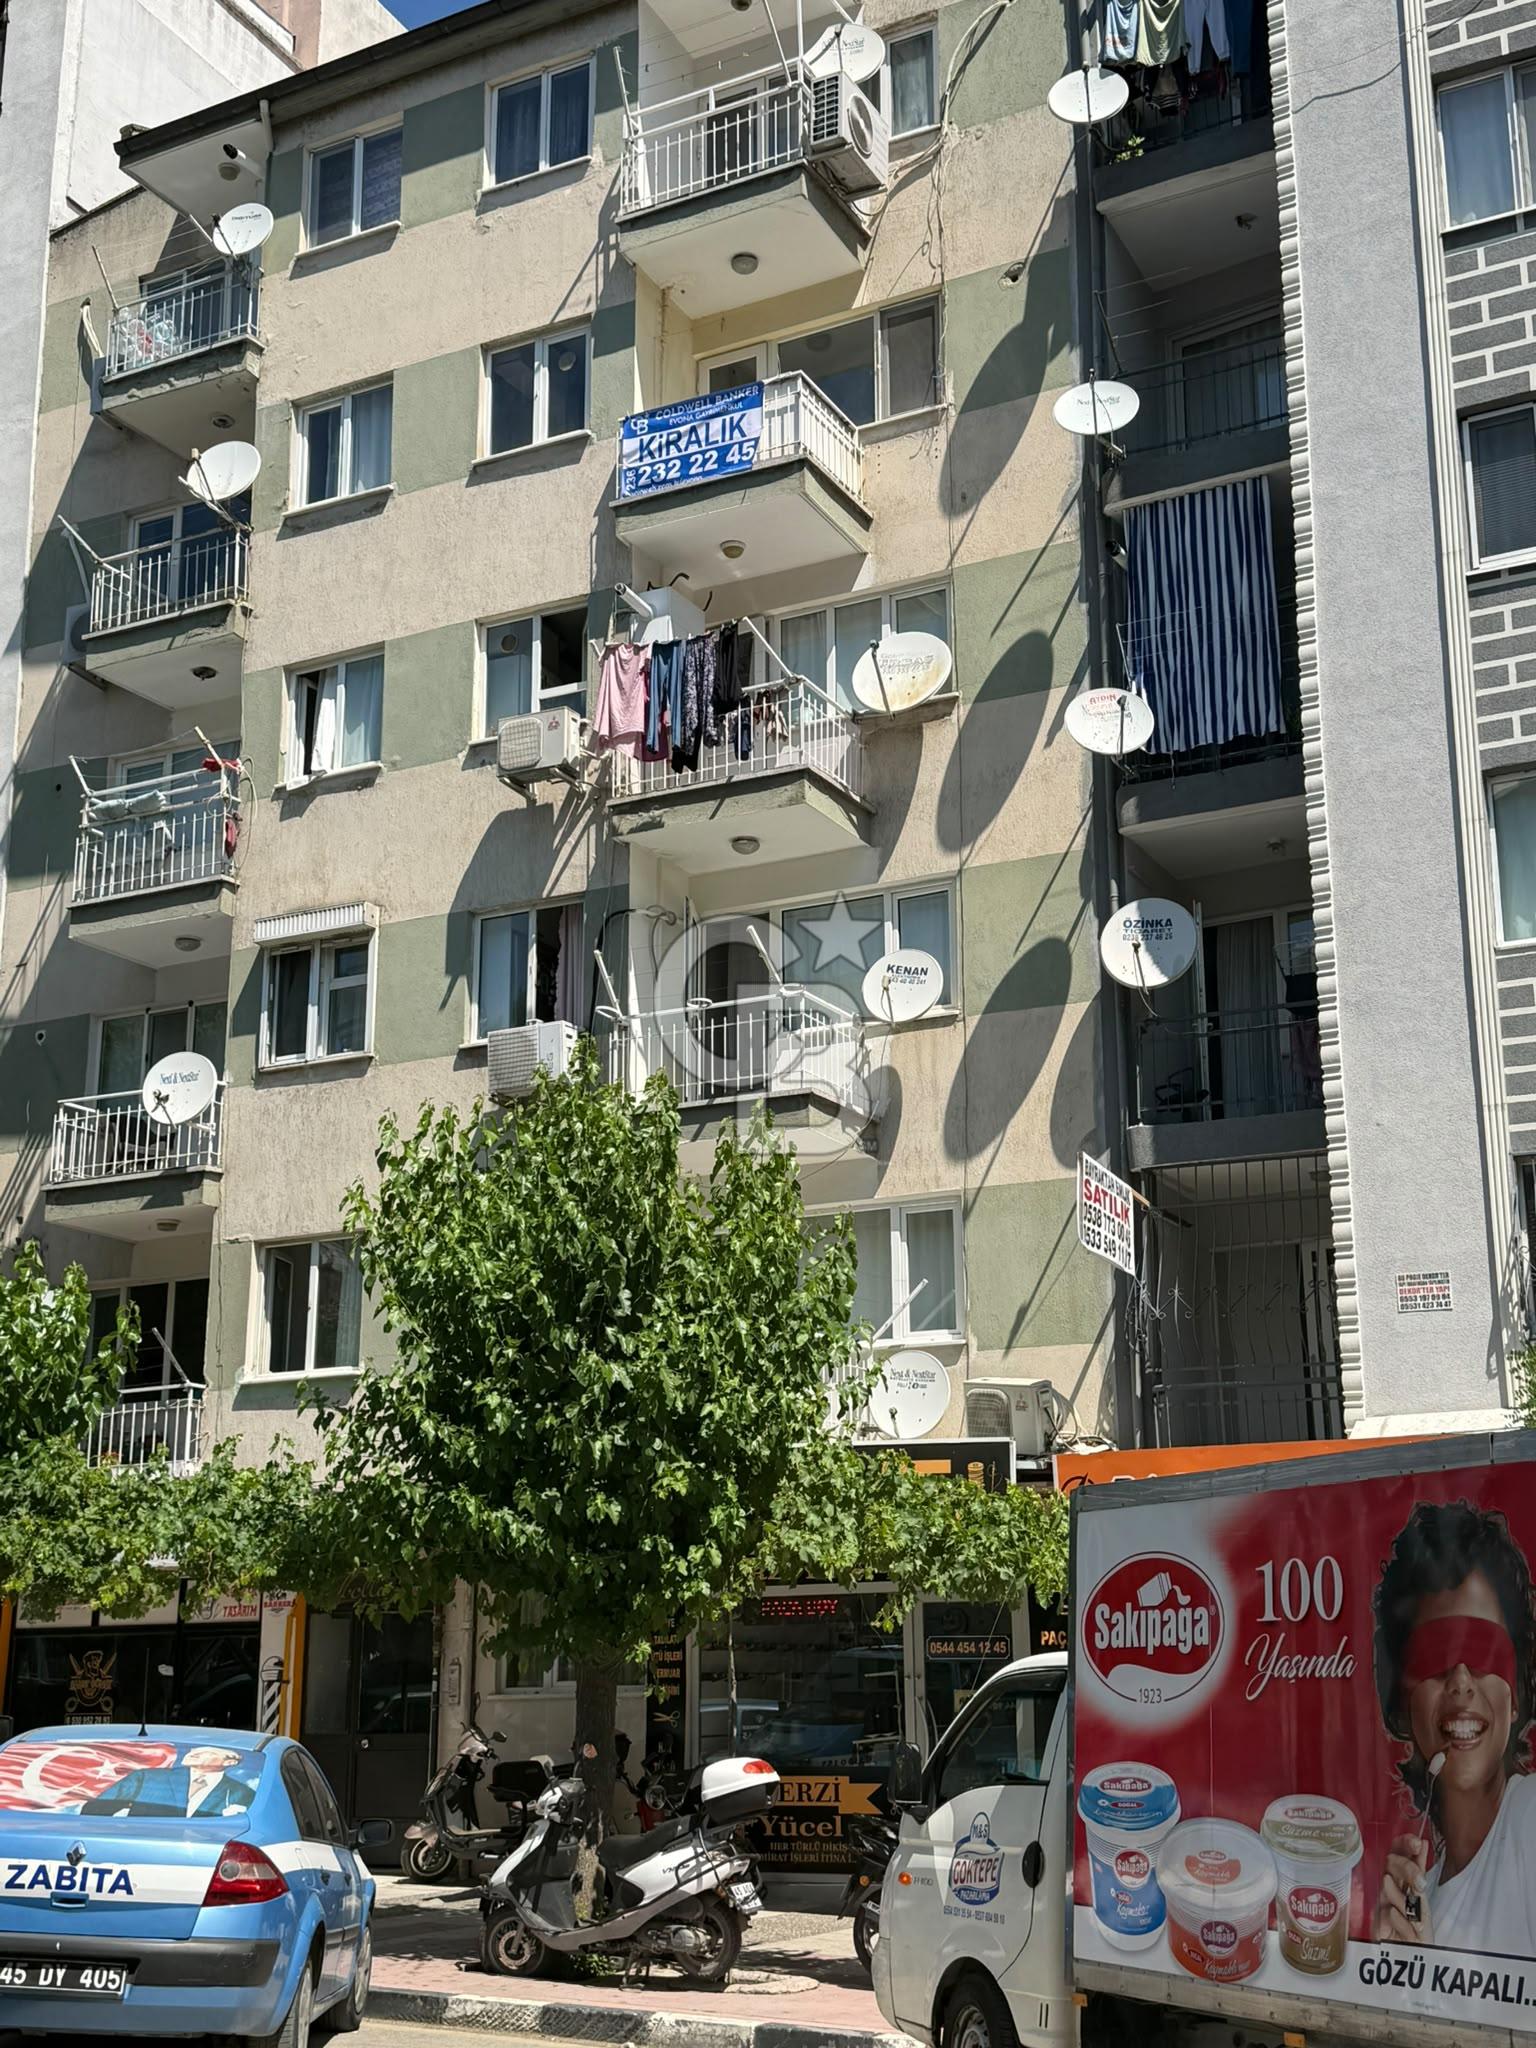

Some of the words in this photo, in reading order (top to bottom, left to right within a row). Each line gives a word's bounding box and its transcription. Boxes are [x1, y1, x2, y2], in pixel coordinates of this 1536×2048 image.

[655, 399, 714, 420] COLDWELL
[715, 385, 759, 403] BANKER
[637, 459, 681, 487] 232
[688, 450, 718, 475] 22
[725, 440, 755, 464] 45
[1123, 917, 1173, 929] ÖZİNKA
[886, 963, 928, 976] KENAN
[1084, 1178, 1131, 1228] SATILIK
[1255, 1555, 1344, 1622] 100
[1040, 1630, 1067, 1649] PAÇ
[1094, 1598, 1209, 1656] Sakıpağa
[930, 1641, 955, 1654] 0544
[956, 1641, 977, 1654] 454
[978, 1641, 992, 1653] 12
[993, 1640, 1007, 1653] 45
[1244, 1632, 1358, 1701] Yaşında
[1138, 1688, 1162, 1704] 1923
[778, 1777, 842, 1803] ERZİ
[757, 1815, 845, 1838] Yücel
[5, 1863, 135, 1896] ZABITA
[0, 1962, 27, 1985] 45
[38, 1963, 68, 1987] DY
[80, 1966, 121, 1990] 405
[1359, 1951, 1426, 1989] GÖZÜ
